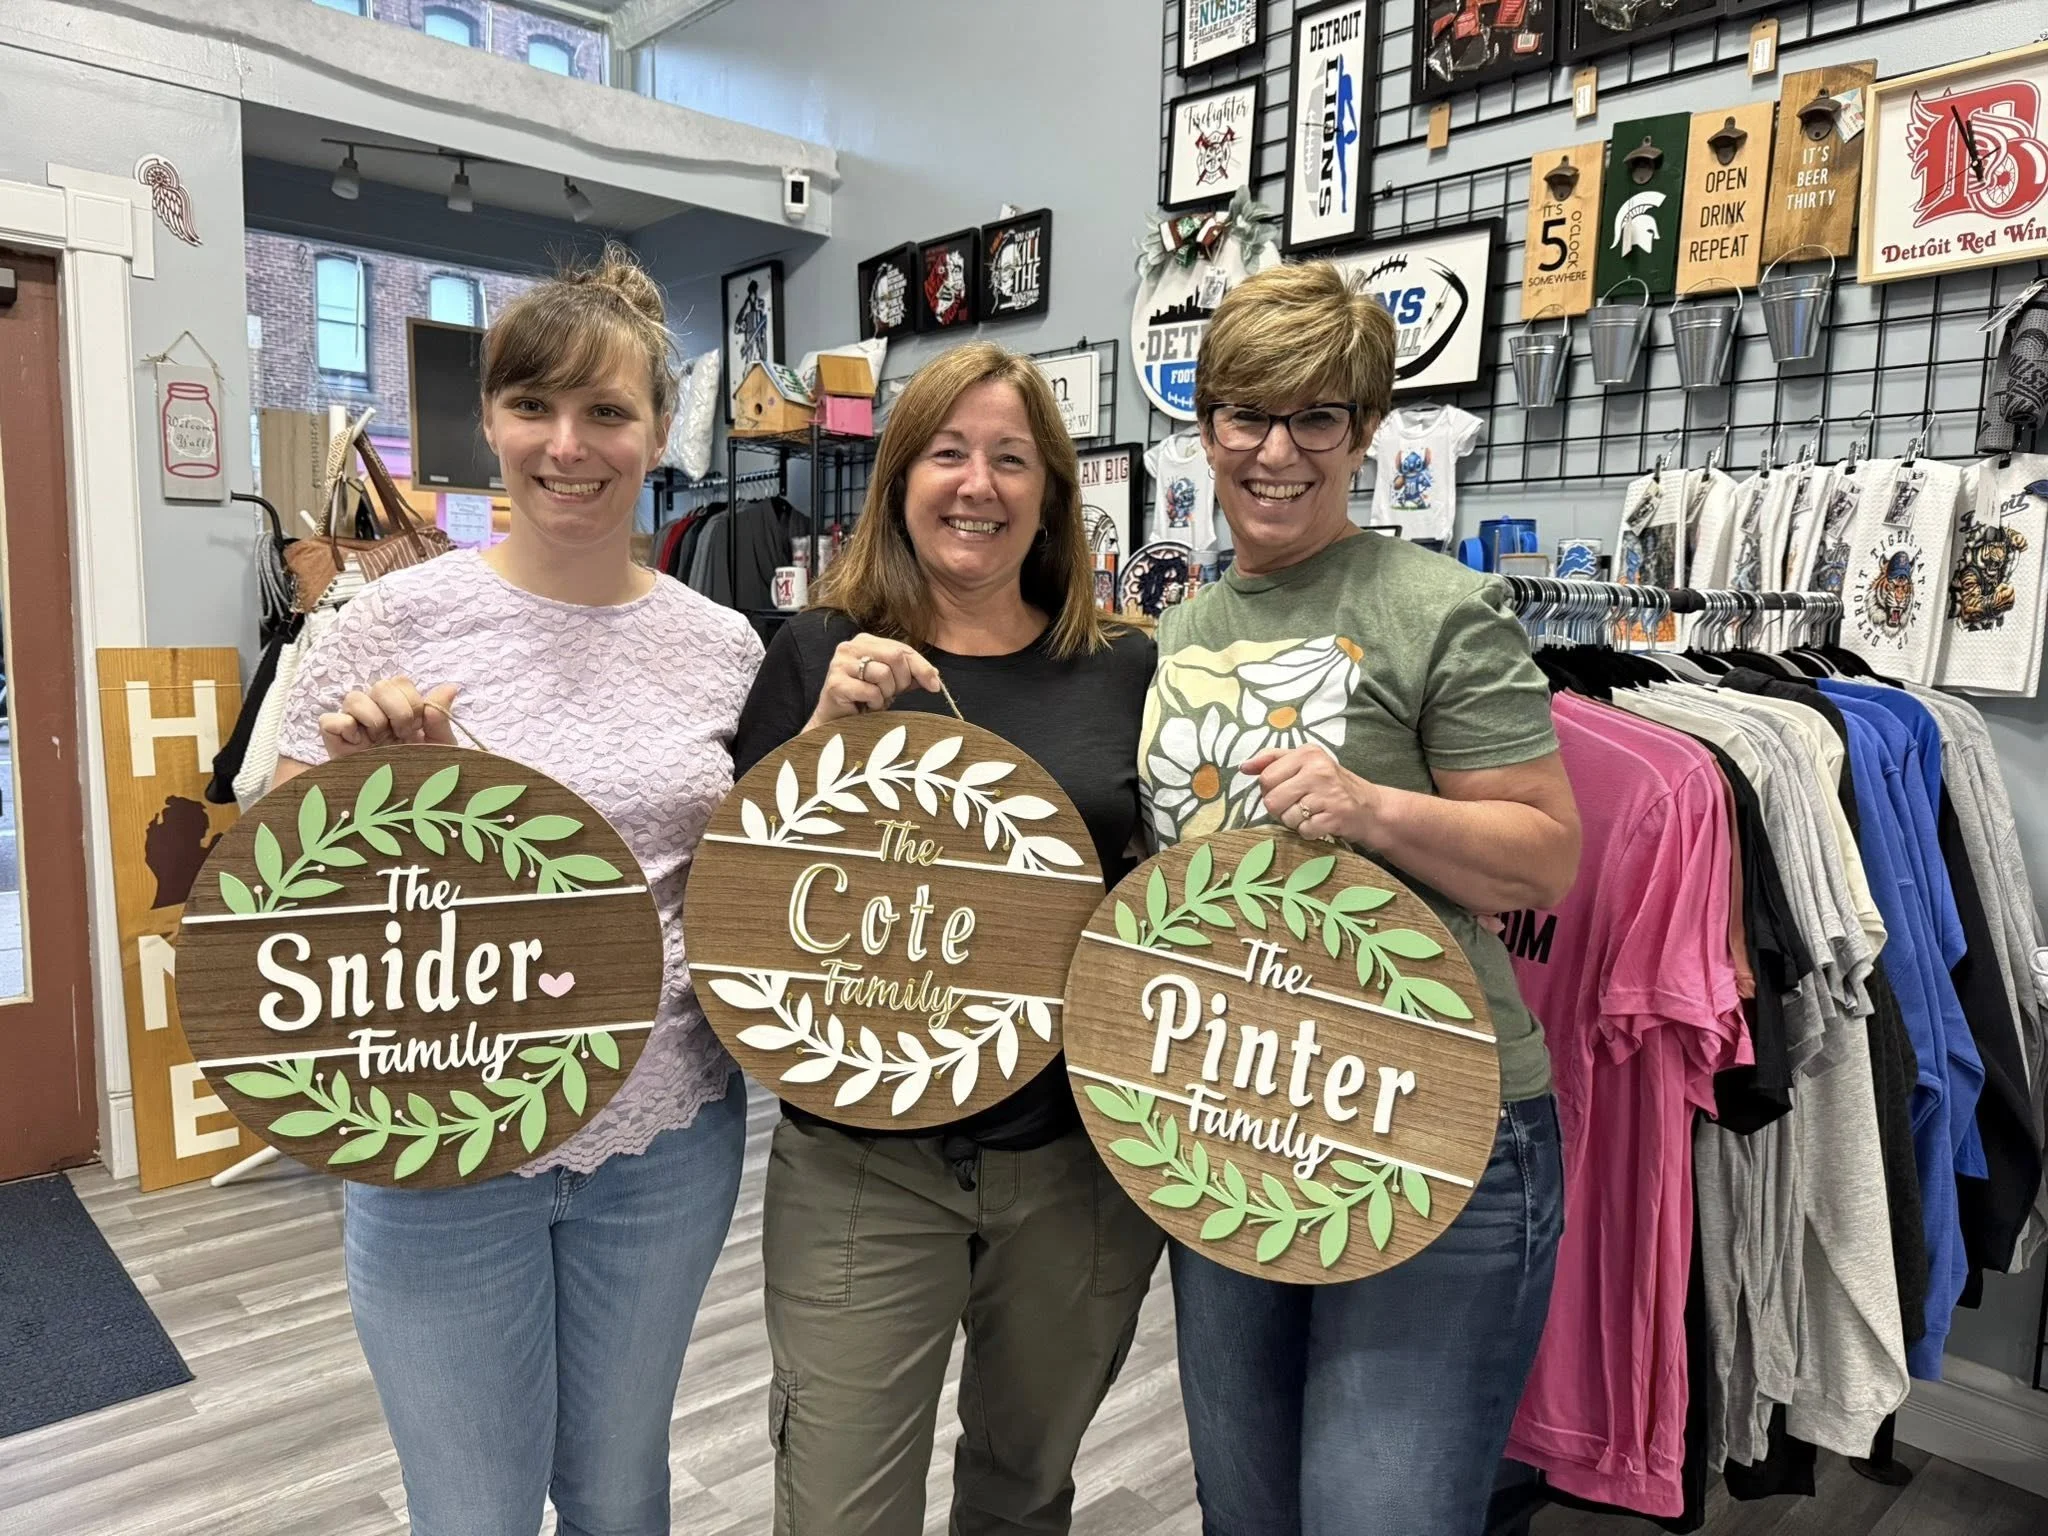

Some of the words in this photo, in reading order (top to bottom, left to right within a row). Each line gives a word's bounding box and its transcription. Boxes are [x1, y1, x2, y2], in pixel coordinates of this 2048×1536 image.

[1310, 11, 1361, 52] DETROIT
[1184, 96, 1248, 134] Firefighter
[1319, 56, 1340, 217] LIONS
[1803, 146, 1830, 164] IT'S
[1705, 166, 1748, 193] OPEN
[1797, 168, 1829, 187] BEER
[1543, 203, 1563, 218] IT'S
[1700, 200, 1747, 228] DRINK
[1787, 189, 1836, 210] THIRTY
[1013, 237, 1041, 266] KILL
[1538, 217, 1568, 271] 5
[1567, 210, 1582, 271] O'CLOCK
[1689, 234, 1749, 263] REPEAT
[1881, 238, 1951, 263] Detroit
[1957, 230, 1996, 255] Red
[2004, 217, 2048, 245] Win
[1014, 262, 1041, 293] THE
[1528, 270, 1588, 287] SOMEWHERE
[1375, 286, 1426, 325] NS
[1146, 322, 1211, 363] DET
[1171, 368, 1196, 384] FOOT
[1081, 461, 1100, 484] AN
[1105, 456, 1129, 482] BIG
[1870, 530, 1915, 559] TIGERS
[875, 819, 944, 865] The
[377, 865, 461, 912] The
[788, 862, 975, 965] Cote
[257, 910, 542, 1032] Snider
[1241, 938, 1312, 994] The
[821, 958, 966, 1029] Family
[348, 1021, 518, 1083] Family
[1141, 973, 1417, 1134] Pinter
[1185, 1083, 1335, 1180] Family
